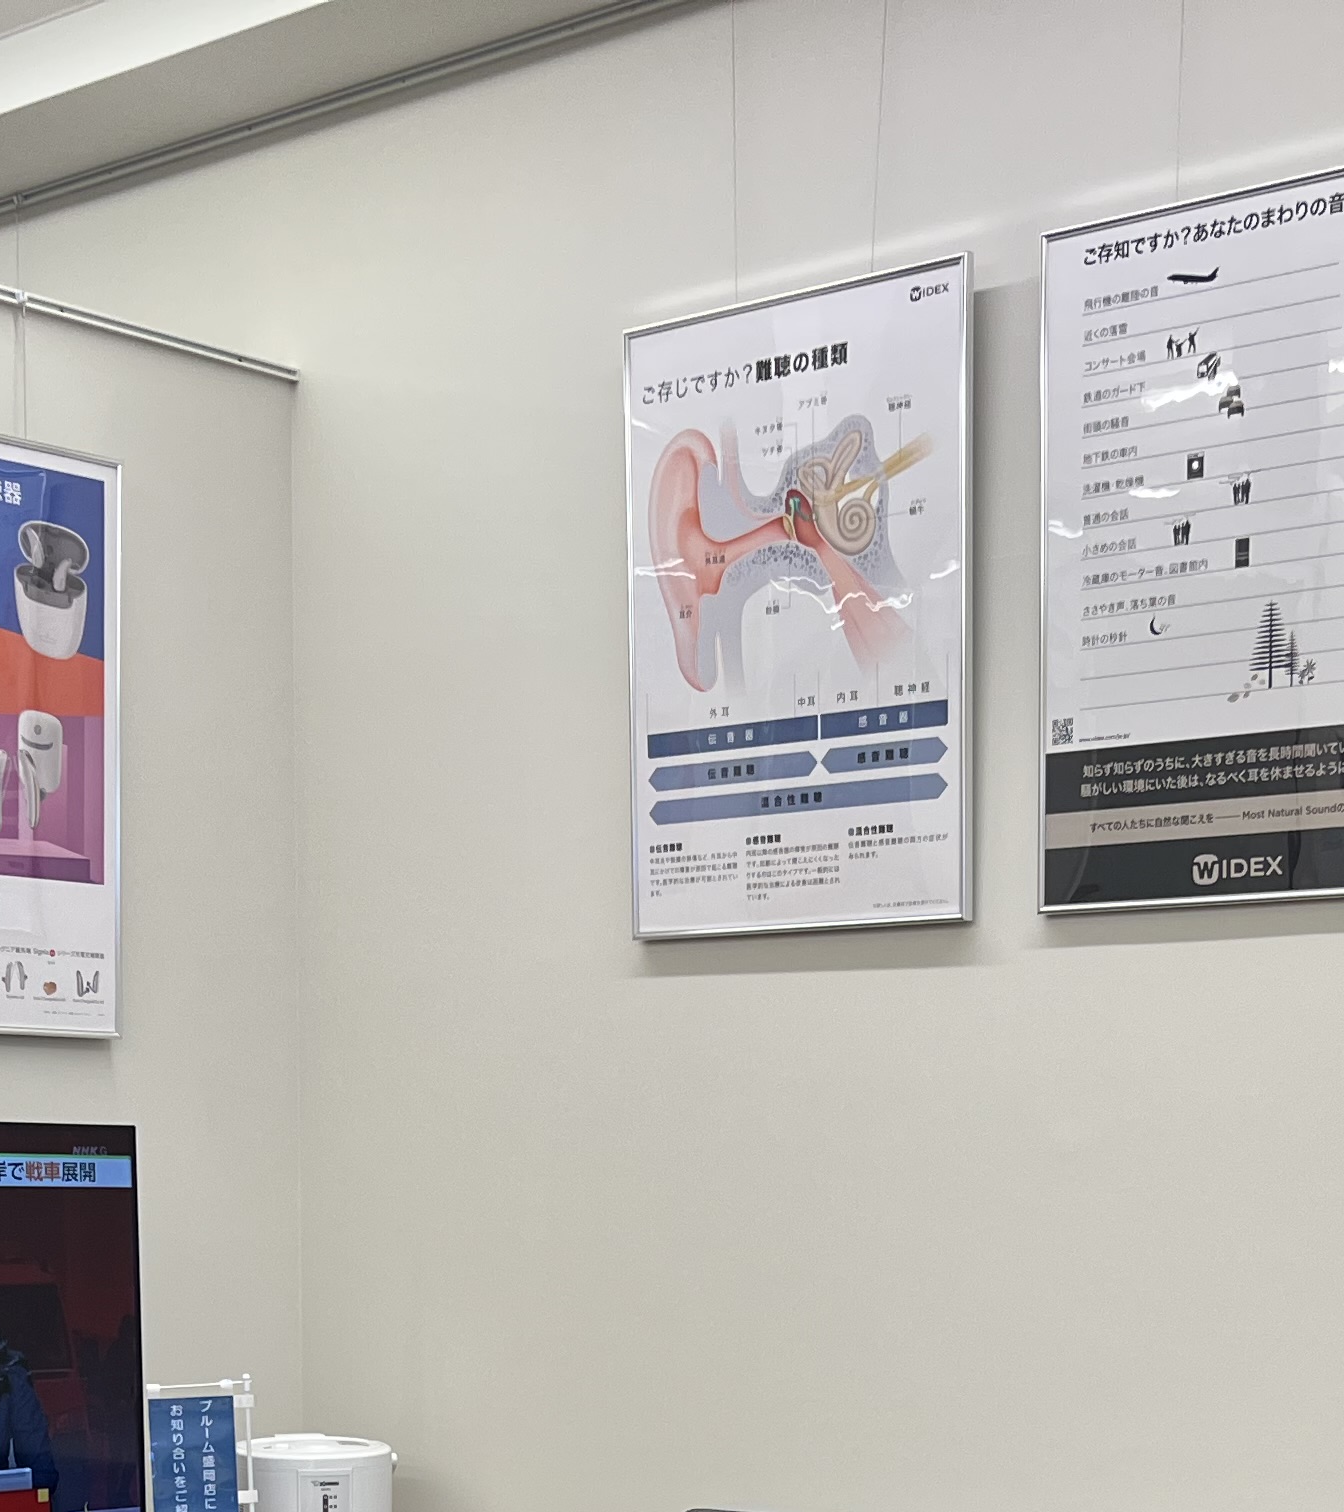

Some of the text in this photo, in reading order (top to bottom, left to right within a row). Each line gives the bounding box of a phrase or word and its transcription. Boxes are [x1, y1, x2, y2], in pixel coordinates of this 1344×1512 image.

[909, 282, 950, 302] WIDEX
[1242, 808, 1266, 821] Most
[1267, 805, 1303, 819] Natural
[1191, 854, 1283, 886] WIDEX
